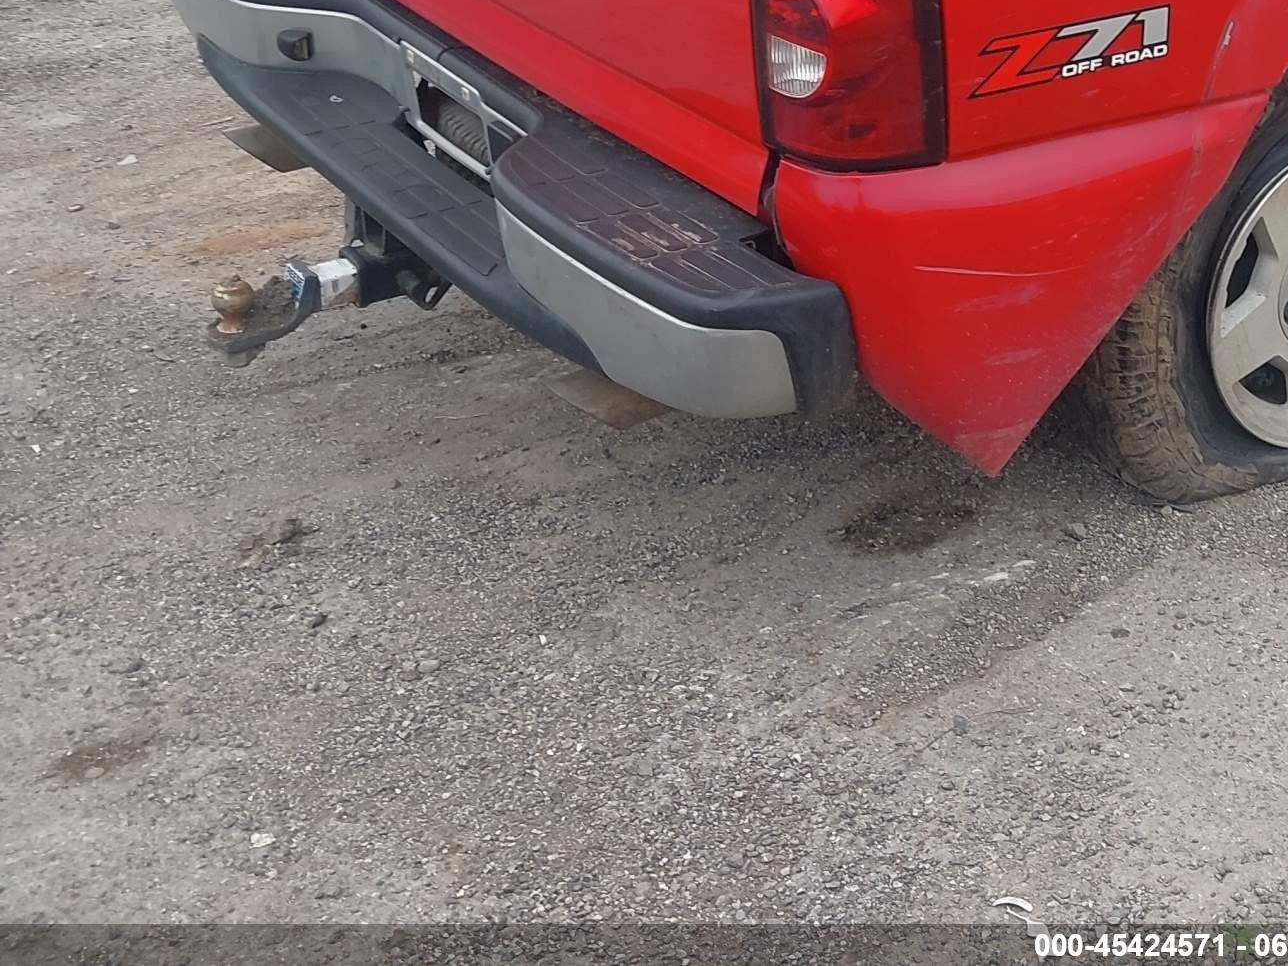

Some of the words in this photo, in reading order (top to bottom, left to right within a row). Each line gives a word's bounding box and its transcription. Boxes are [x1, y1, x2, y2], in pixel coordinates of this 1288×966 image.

[968, 4, 1170, 99] Z71
[1061, 58, 1104, 78] OFF
[1110, 43, 1168, 67] ROAD
